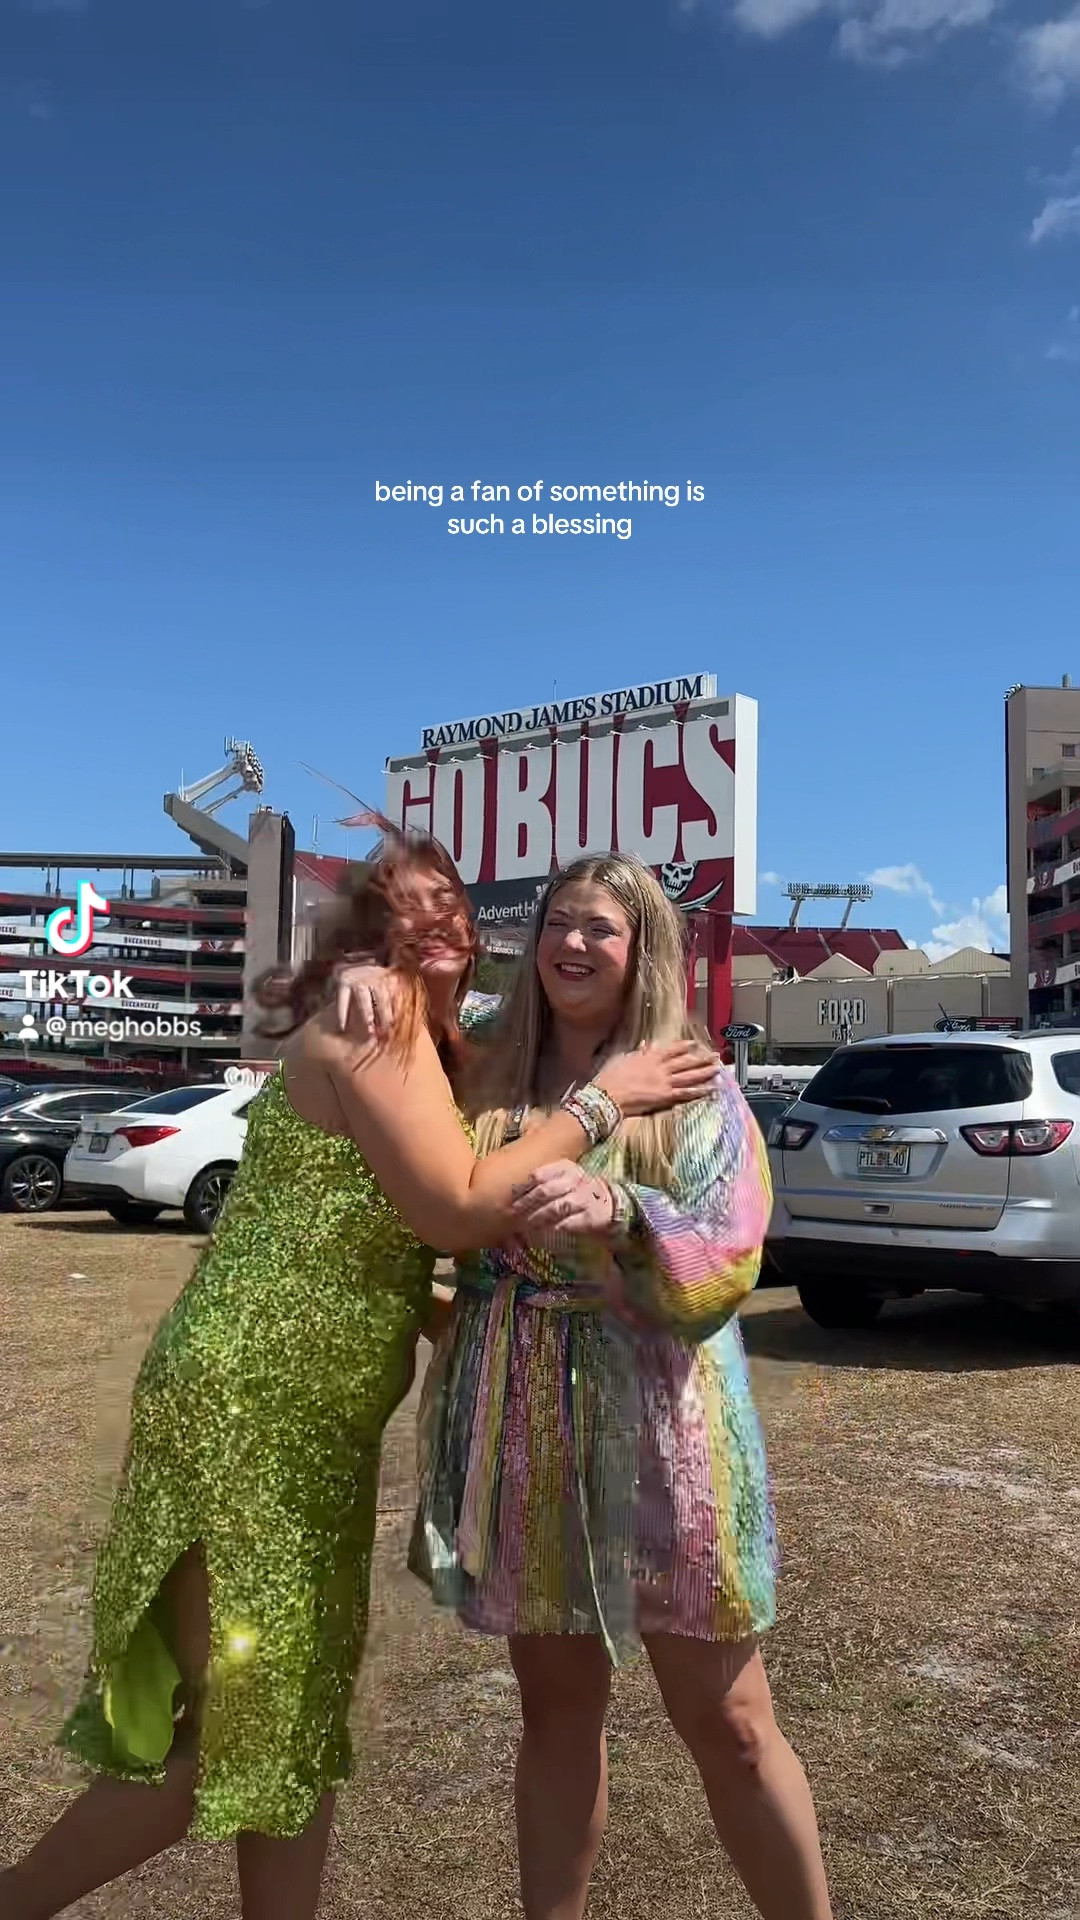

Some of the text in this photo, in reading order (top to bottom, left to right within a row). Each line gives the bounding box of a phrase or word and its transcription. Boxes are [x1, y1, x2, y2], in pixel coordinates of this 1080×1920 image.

[421, 674, 704, 750] RAYMOND JAMES STADIUM
[386, 702, 736, 886] GO BUCS
[725, 1025, 751, 1037] Ford
[817, 999, 866, 1025] FORD
